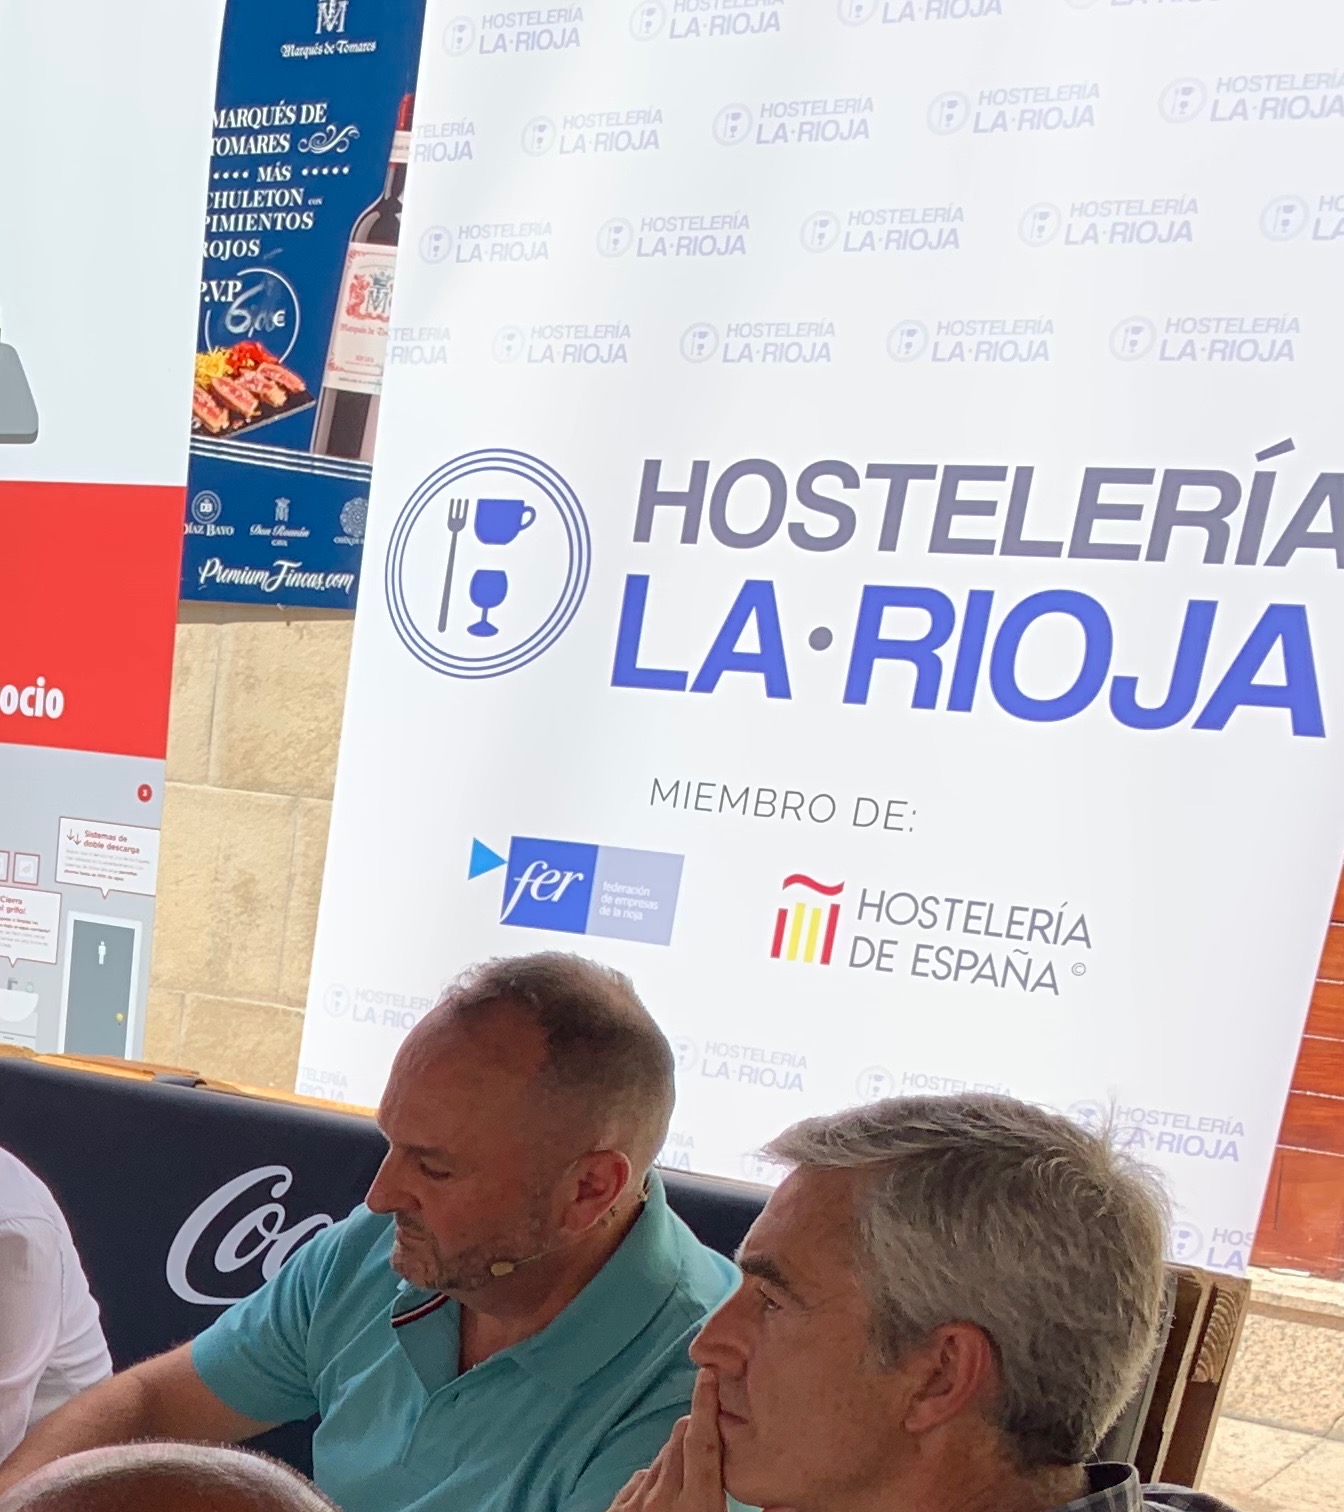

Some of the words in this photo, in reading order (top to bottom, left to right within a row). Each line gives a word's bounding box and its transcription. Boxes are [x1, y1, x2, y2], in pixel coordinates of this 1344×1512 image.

[482, 7, 583, 29] HOSTELERÍA
[280, 42, 322, 59] Marqués
[323, 41, 336, 54] de
[337, 40, 376, 54] Tomares
[979, 82, 1100, 106] HOSTELERÍA
[212, 100, 296, 129] MARQUÉS
[300, 102, 327, 124] DE
[760, 95, 874, 120] HOSTELERÍA
[562, 109, 663, 129] HOSTELERÍA
[257, 162, 292, 182] MÁS
[848, 203, 964, 226] HOSTELERÍA
[1070, 193, 1199, 219] HOSTELERÍA
[204, 211, 313, 232] PIMIENTOS
[458, 221, 552, 239] HOSTELERÍA
[641, 210, 750, 232] HOSTELERÍA
[202, 238, 261, 261] ROJOS
[530, 320, 631, 340] HOSTELERÍA
[726, 317, 835, 339] HOSTELERÍA
[937, 315, 1054, 337] HOSTELERÍA
[1165, 314, 1300, 335] HOSTELERÍA
[632, 436, 1344, 570] HOSTELERÍA
[206, 523, 235, 537] BAYO
[649, 777, 838, 823] MIEMBRO
[851, 796, 919, 833] DE:
[85, 829, 116, 843] Sistemas
[118, 835, 128, 843] de
[106, 843, 140, 855] descarga
[499, 860, 584, 924] fer
[603, 881, 651, 896] federación
[599, 905, 610, 916] de
[613, 906, 622, 917] la
[623, 908, 643, 921] rioja
[601, 894, 612, 904] de
[614, 896, 659, 911] empresas
[858, 887, 1093, 950] HOSTELERÍA
[850, 935, 900, 974] DE
[911, 947, 1061, 996] ESPAÑA
[705, 1041, 807, 1069] HOSTELERÍA
